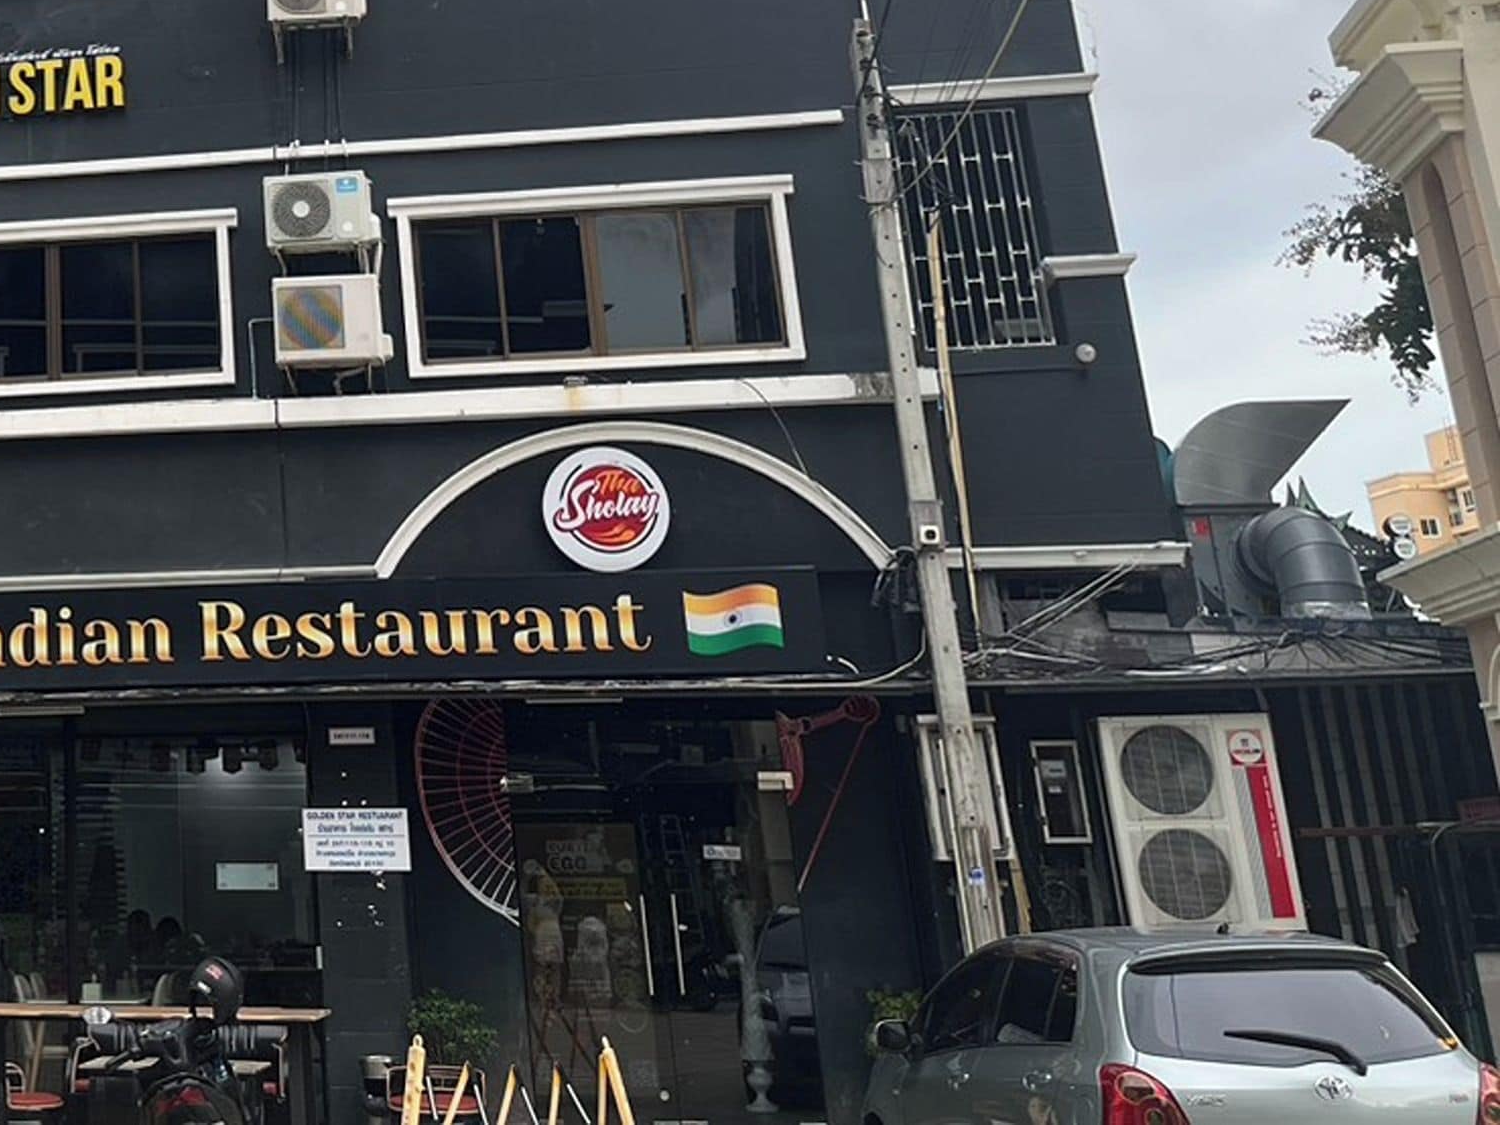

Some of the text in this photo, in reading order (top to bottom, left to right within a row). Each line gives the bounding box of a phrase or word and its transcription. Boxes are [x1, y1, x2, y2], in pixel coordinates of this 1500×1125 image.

[7, 55, 126, 116] STAR
[555, 479, 658, 530] Sholay
[198, 593, 653, 661] Restaurant
